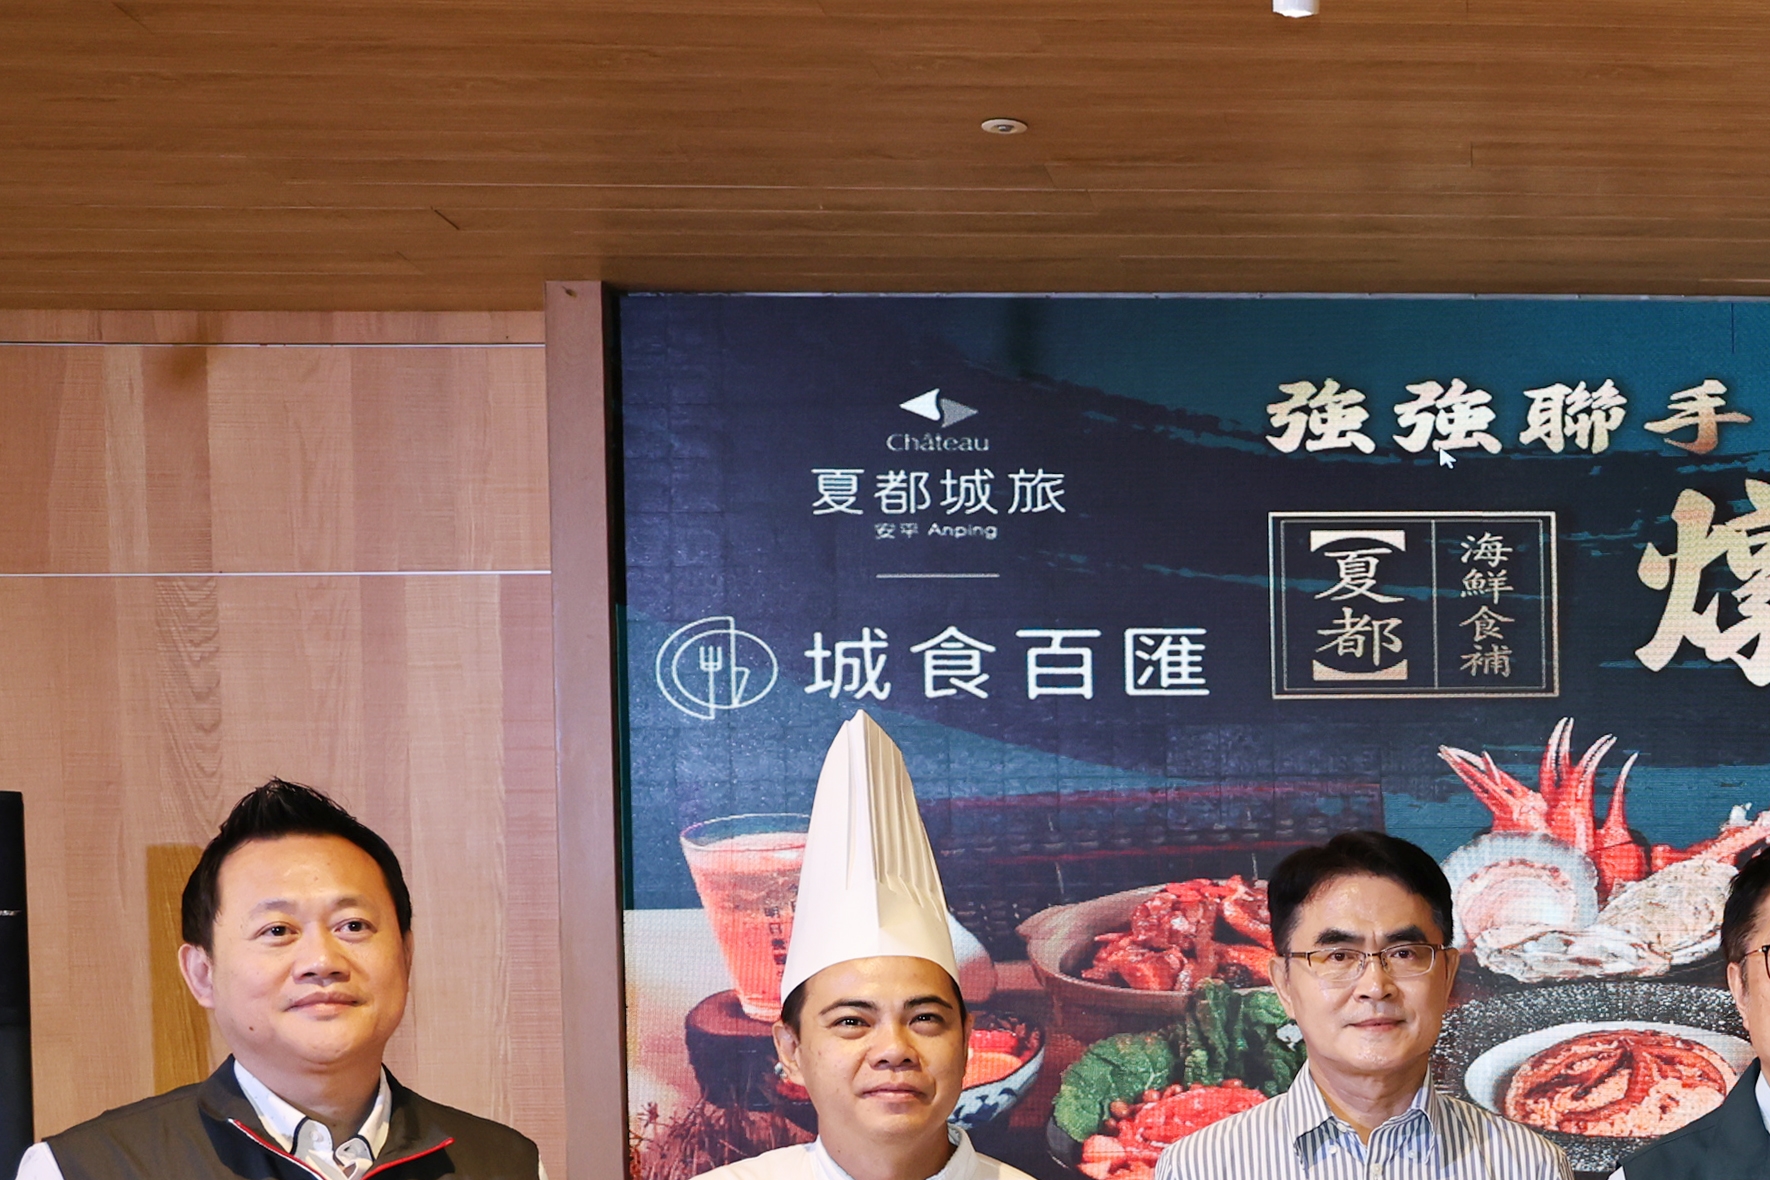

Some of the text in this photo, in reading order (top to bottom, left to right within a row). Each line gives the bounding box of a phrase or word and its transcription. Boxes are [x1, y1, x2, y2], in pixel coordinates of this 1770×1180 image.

[886, 431, 989, 452] Château
[1266, 377, 1752, 454] 強強聯手
[811, 468, 1066, 515] 夏都城旅
[875, 523, 997, 541] 安平 Anping
[1460, 532, 1515, 678] 海鮮食補
[804, 627, 1210, 700] 城食百匯
